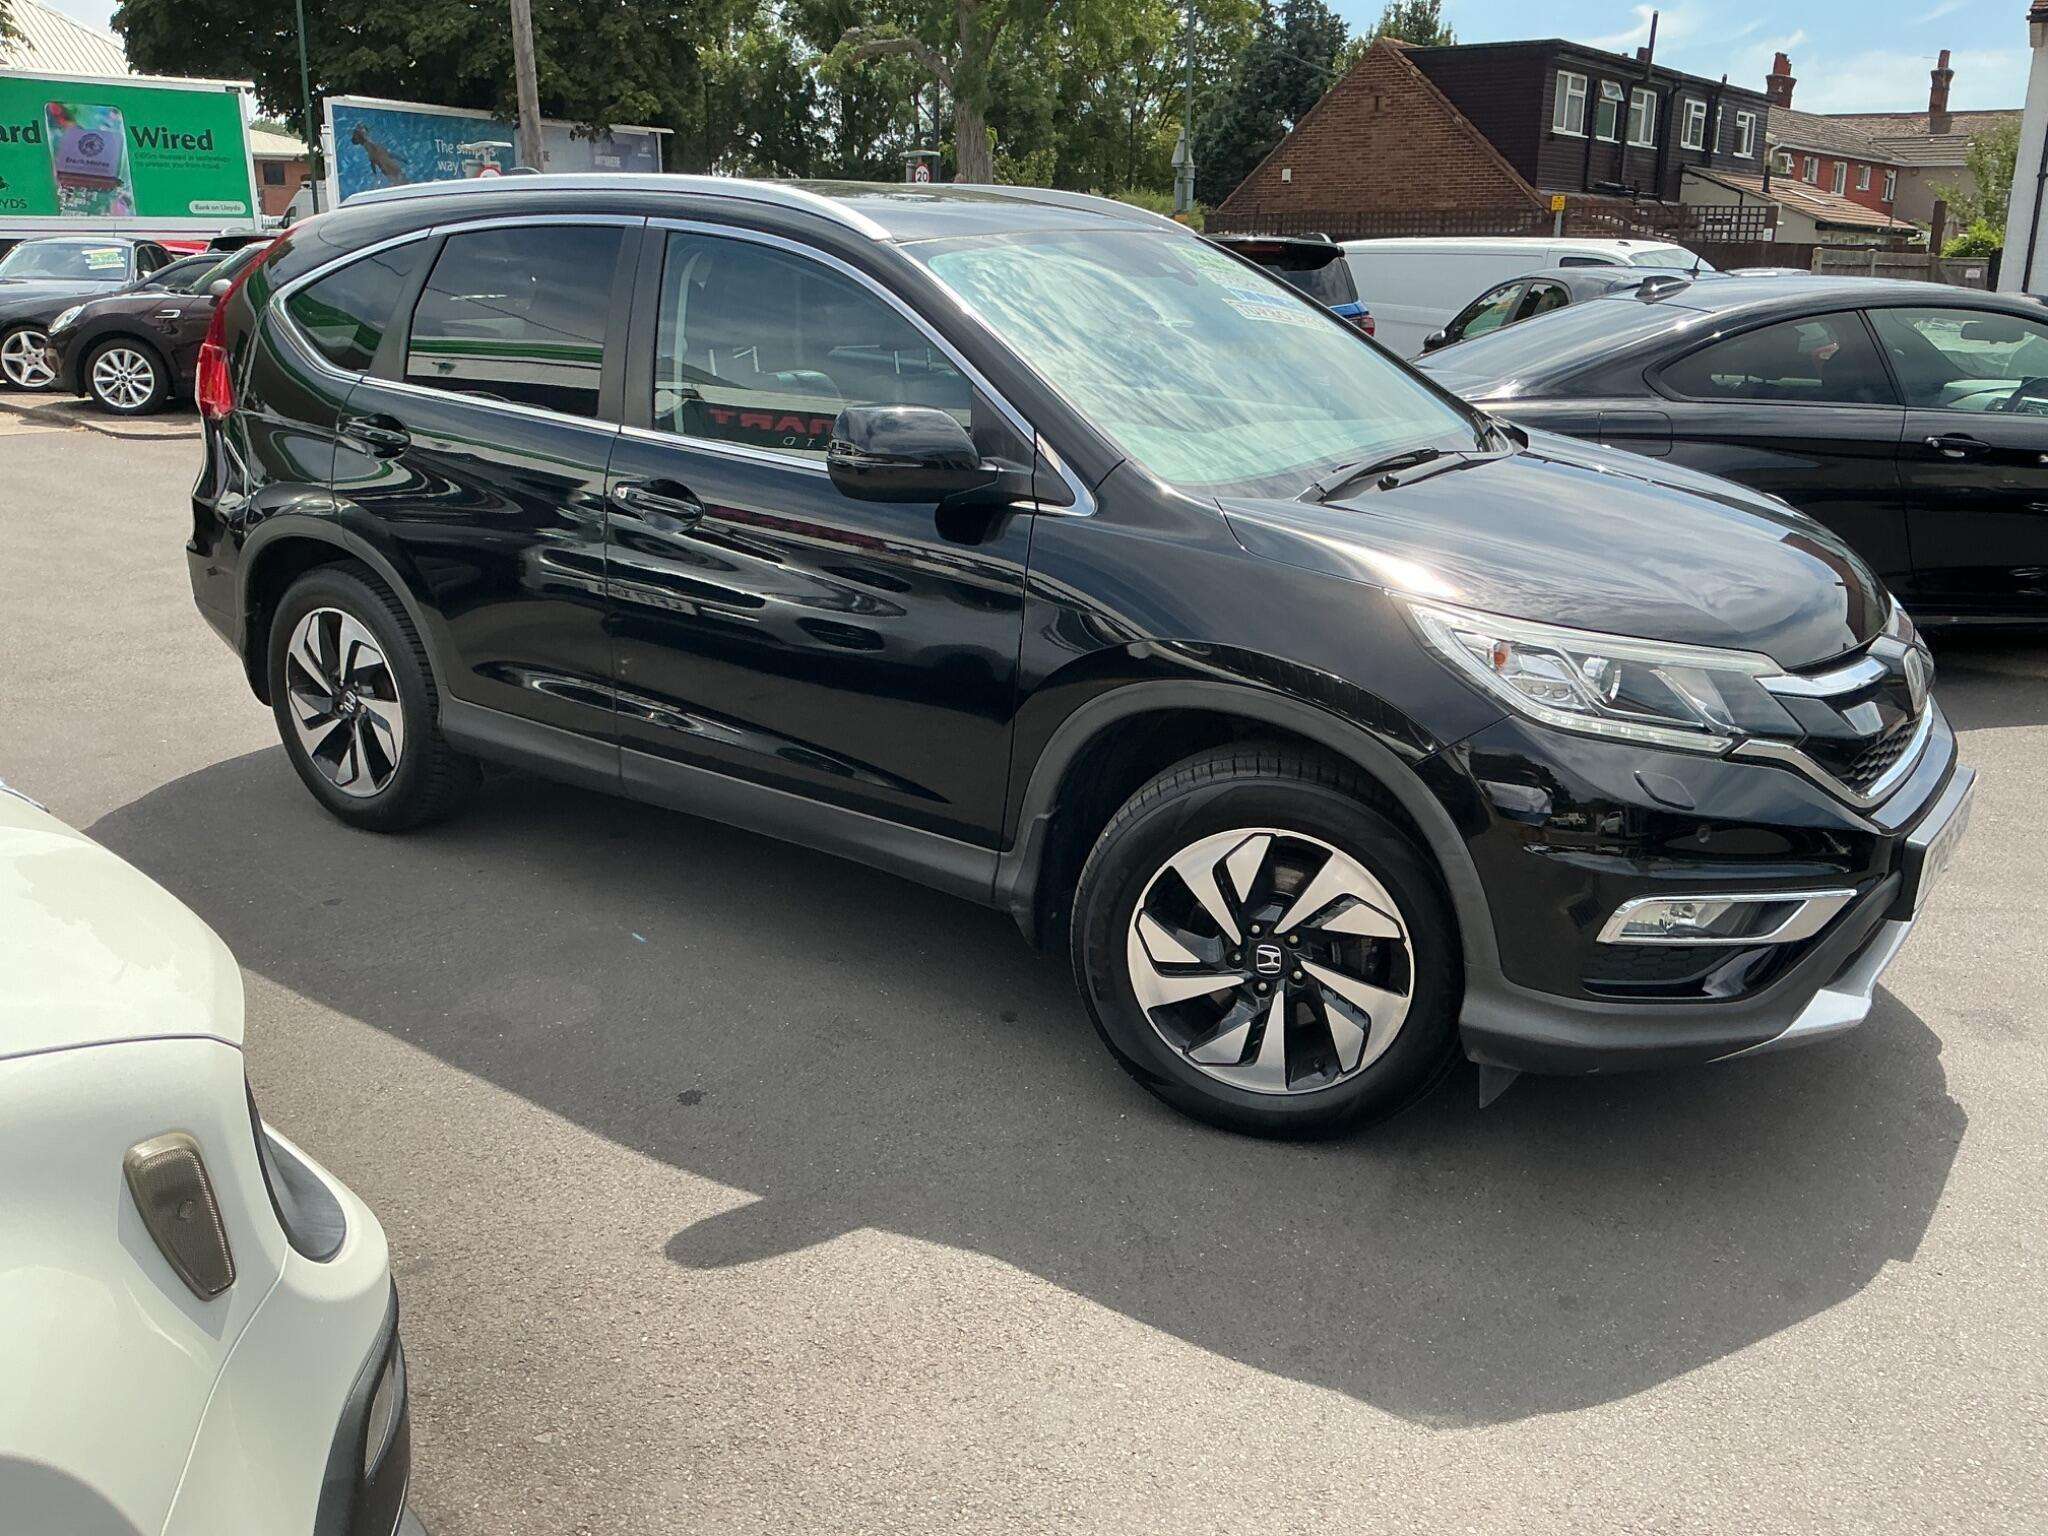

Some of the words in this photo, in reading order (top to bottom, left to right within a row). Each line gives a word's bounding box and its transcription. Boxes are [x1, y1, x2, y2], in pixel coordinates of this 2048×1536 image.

[129, 126, 213, 150] Wired
[434, 139, 454, 154] The
[456, 140, 496, 159] simps
[437, 160, 459, 176] way
[917, 171, 928, 182] 20
[0, 198, 28, 209] YDS
